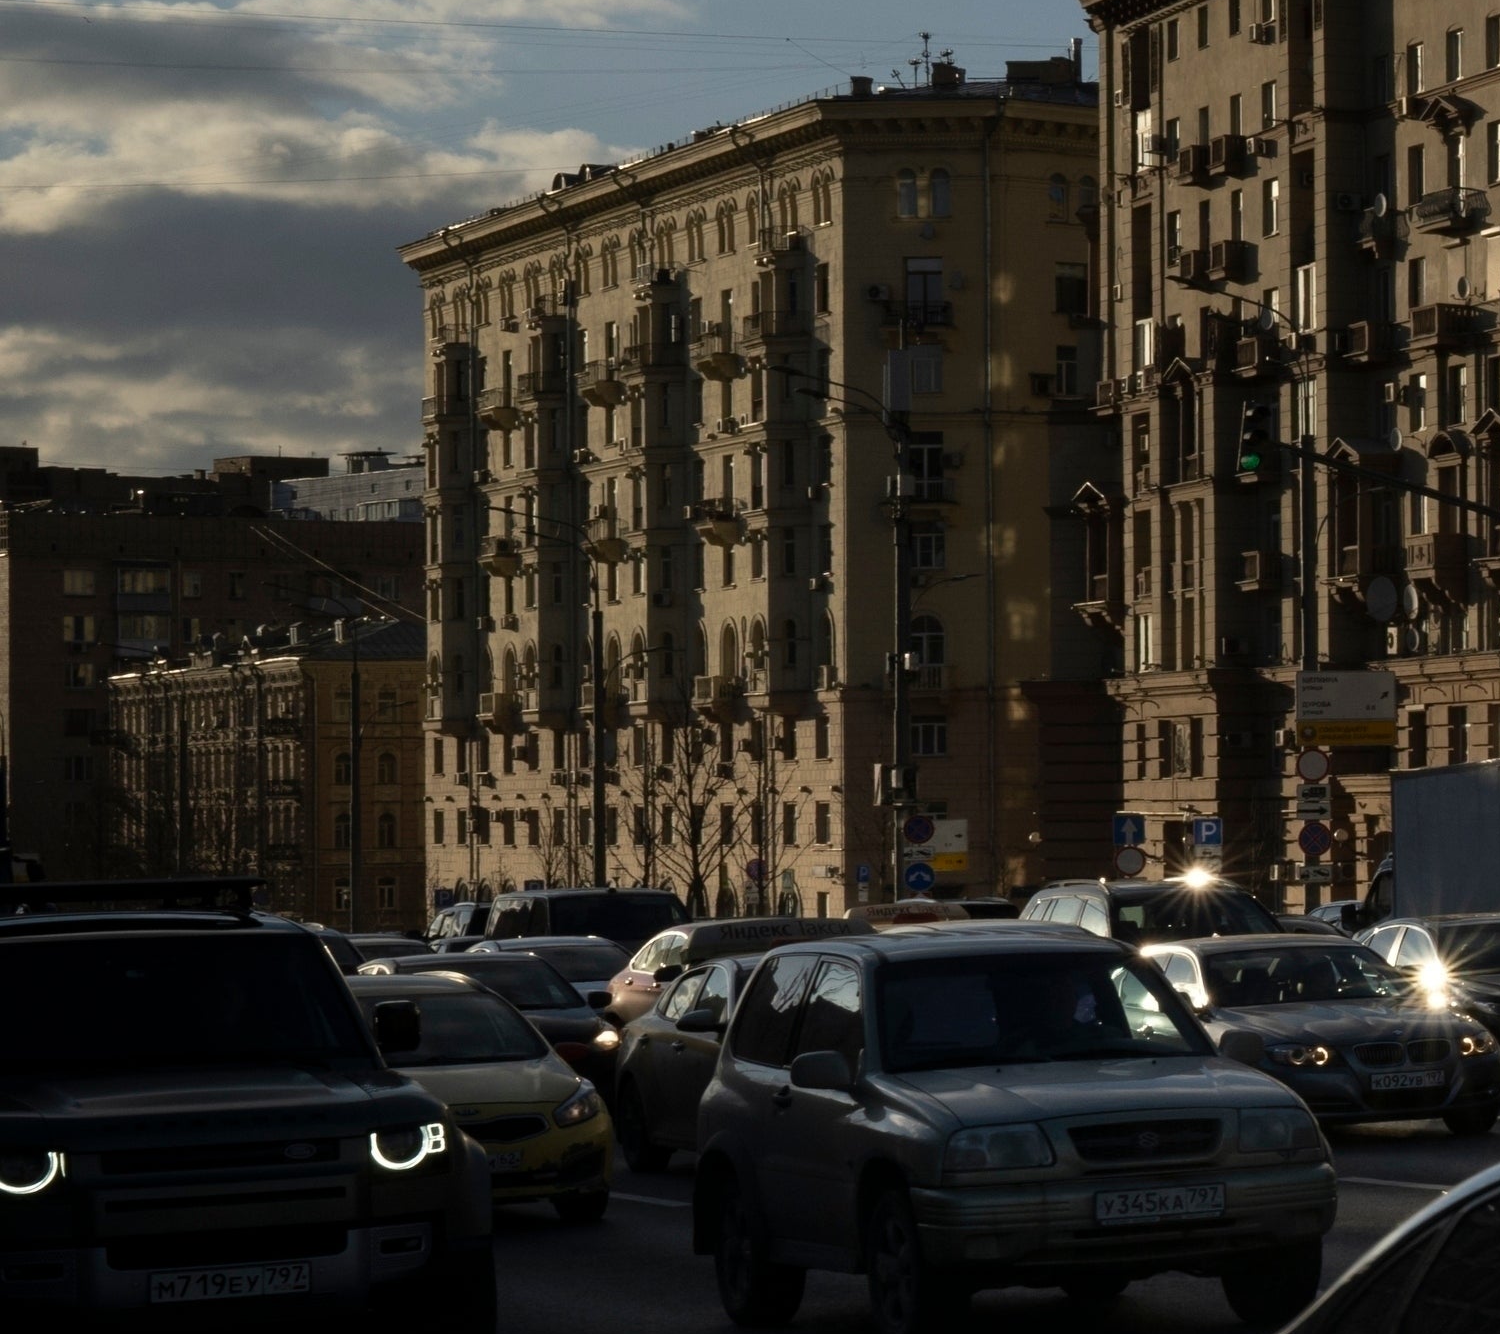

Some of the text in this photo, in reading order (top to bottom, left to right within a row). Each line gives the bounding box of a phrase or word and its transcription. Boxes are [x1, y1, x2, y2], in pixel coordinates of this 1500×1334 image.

[866, 905, 913, 917] Яндекс
[720, 920, 850, 940] Яндекс Такси
[1103, 1186, 1219, 1215] У345КА 797
[158, 1265, 304, 1299] М719ЕУ 797
